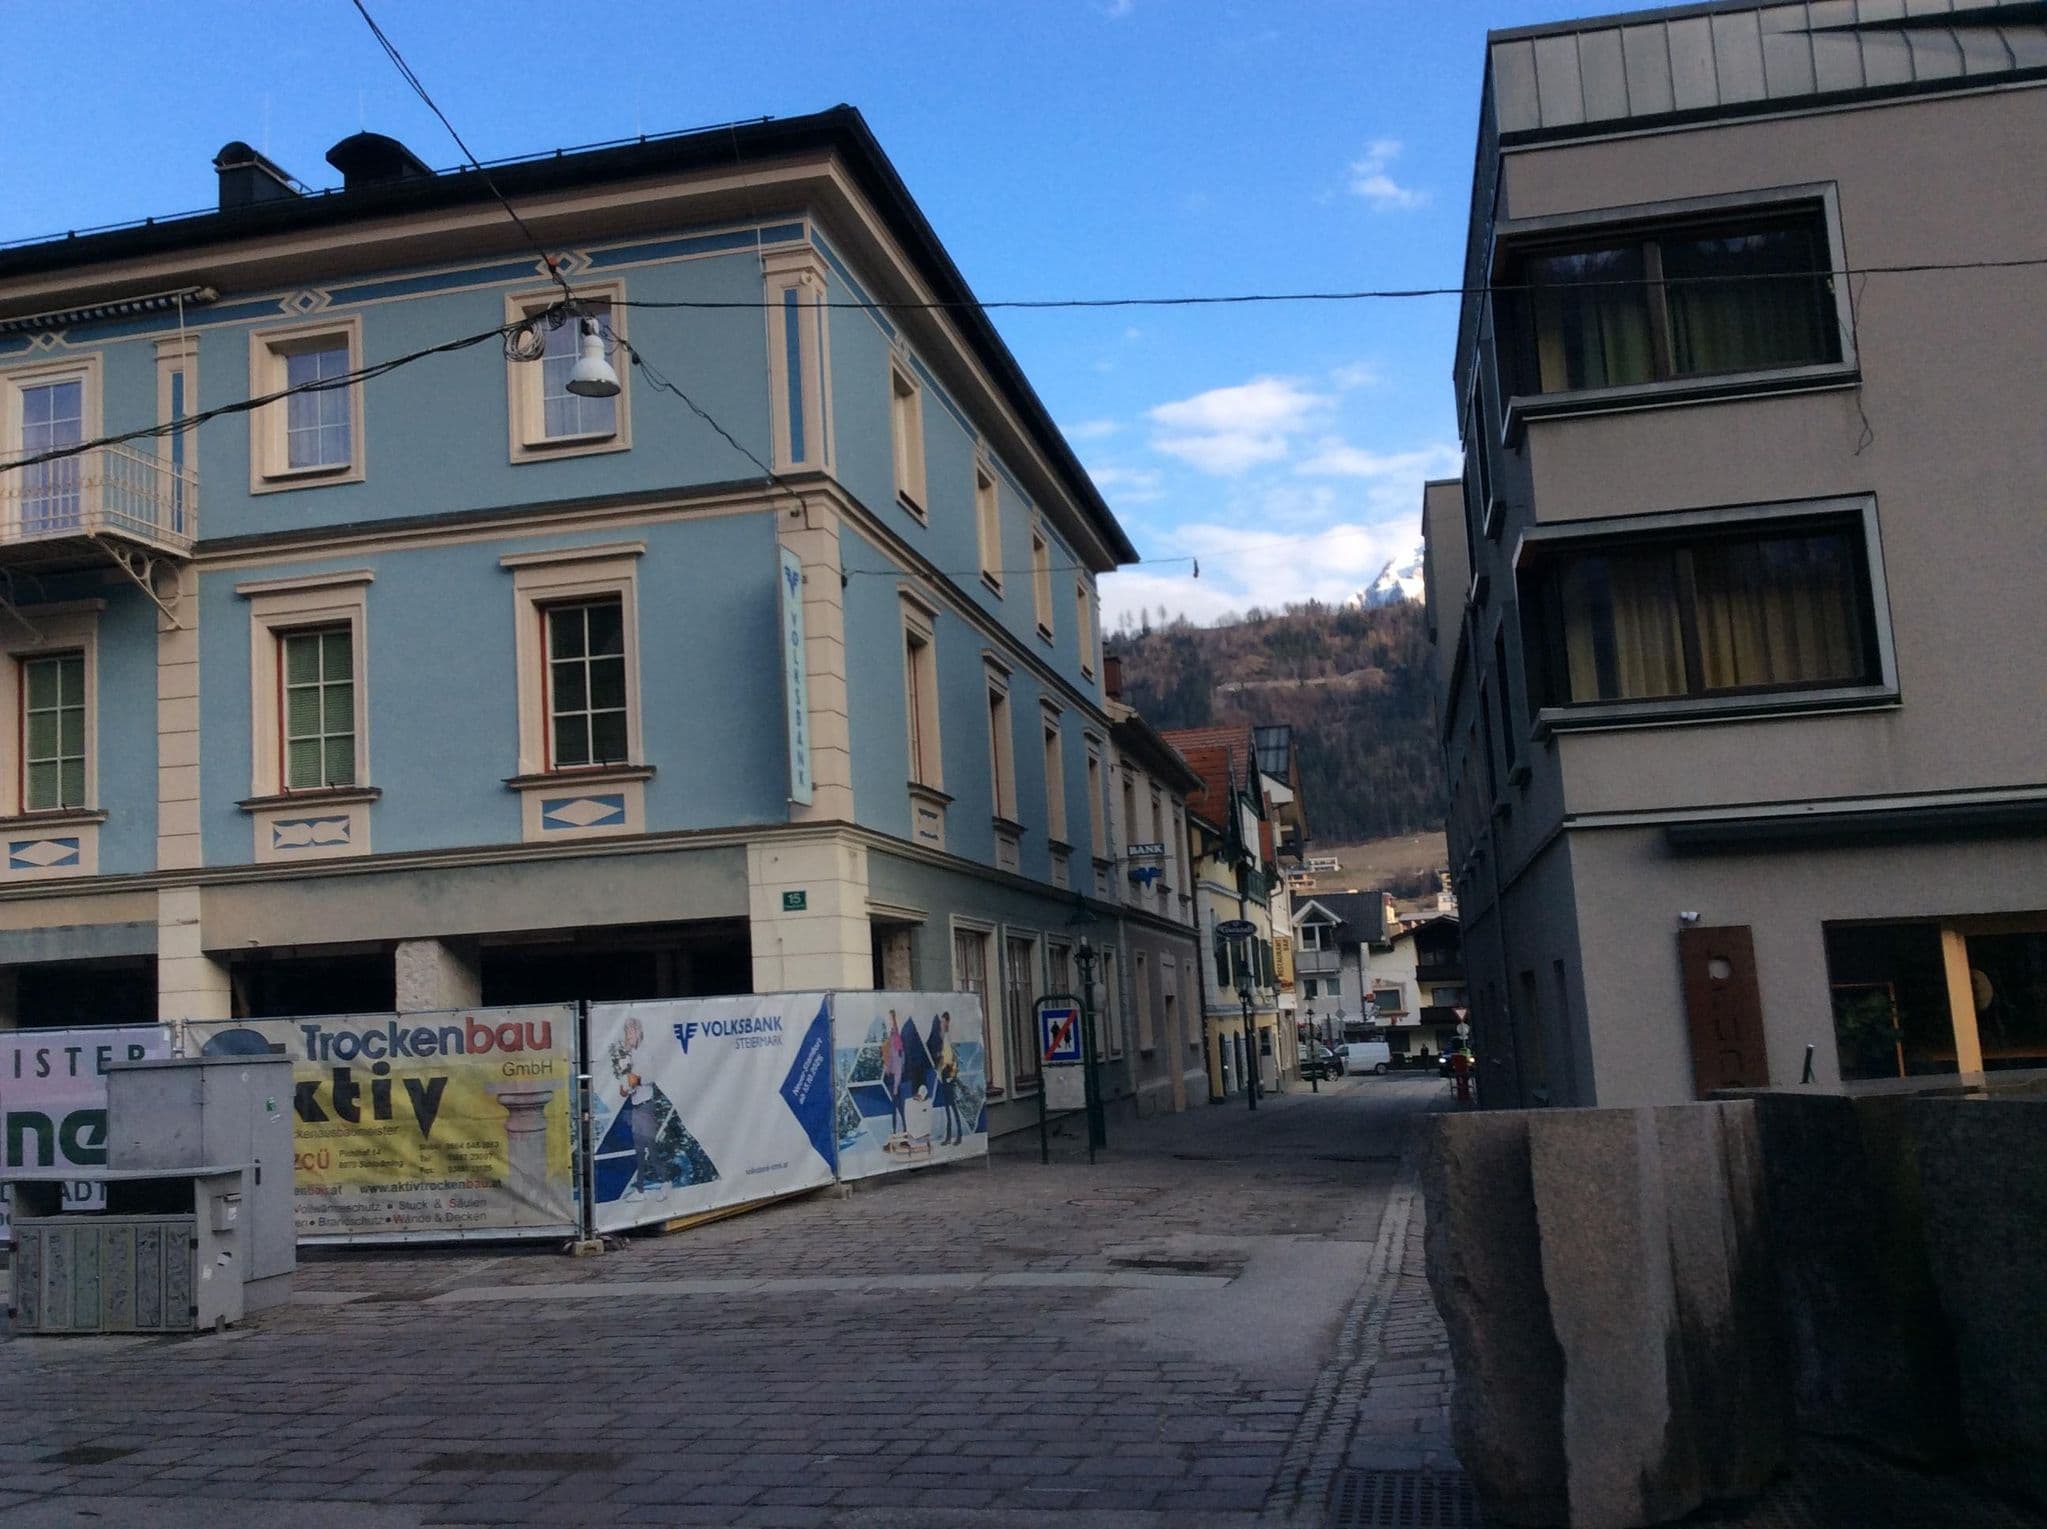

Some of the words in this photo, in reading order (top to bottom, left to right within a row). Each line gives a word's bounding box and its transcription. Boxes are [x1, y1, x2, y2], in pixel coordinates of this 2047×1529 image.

[1128, 844, 1163, 855] BANK
[787, 893, 802, 904] 15
[701, 1015, 782, 1038] VOLKSBANK
[301, 1017, 552, 1062] Trockenbau
[735, 1035, 783, 1050] STEIERMARK
[502, 1061, 553, 1077] GmbH
